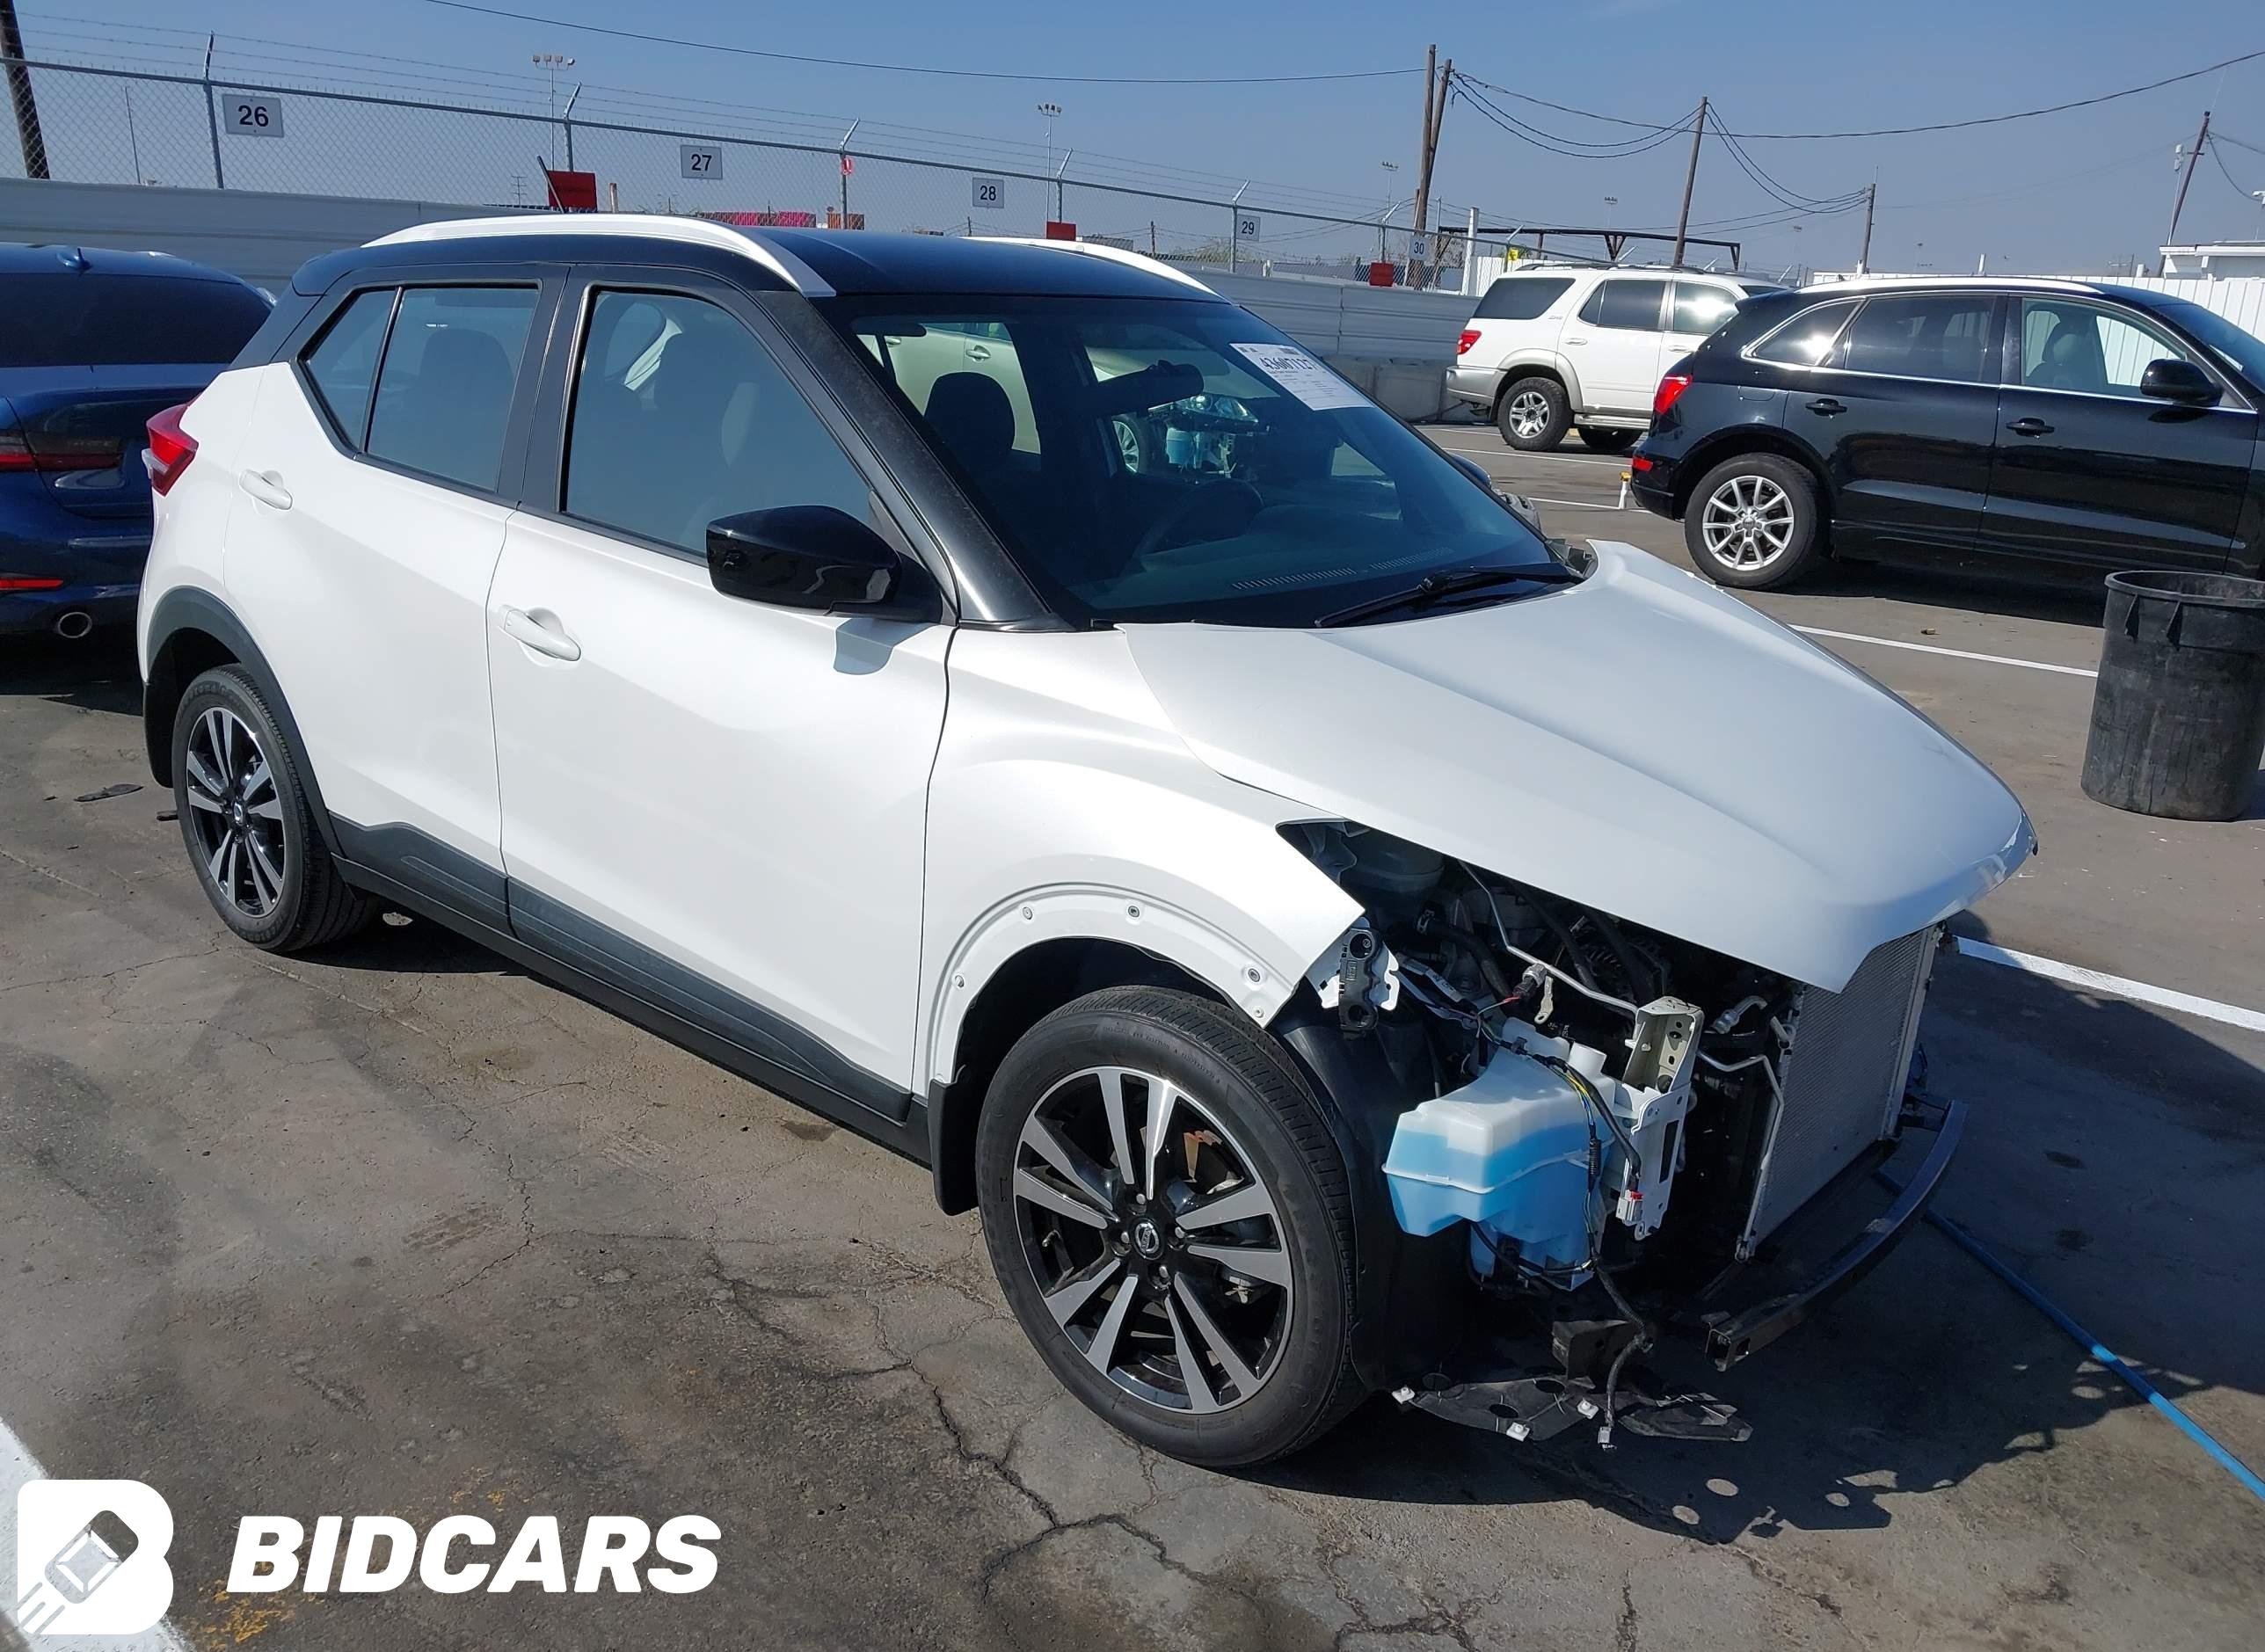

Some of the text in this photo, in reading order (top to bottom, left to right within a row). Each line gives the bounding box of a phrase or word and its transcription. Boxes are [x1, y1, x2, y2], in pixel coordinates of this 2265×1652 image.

[237, 105, 269, 127] 26
[691, 153, 712, 171] 27
[980, 185, 996, 201] 28
[1242, 221, 1255, 235] 29
[1413, 241, 1424, 255] 30
